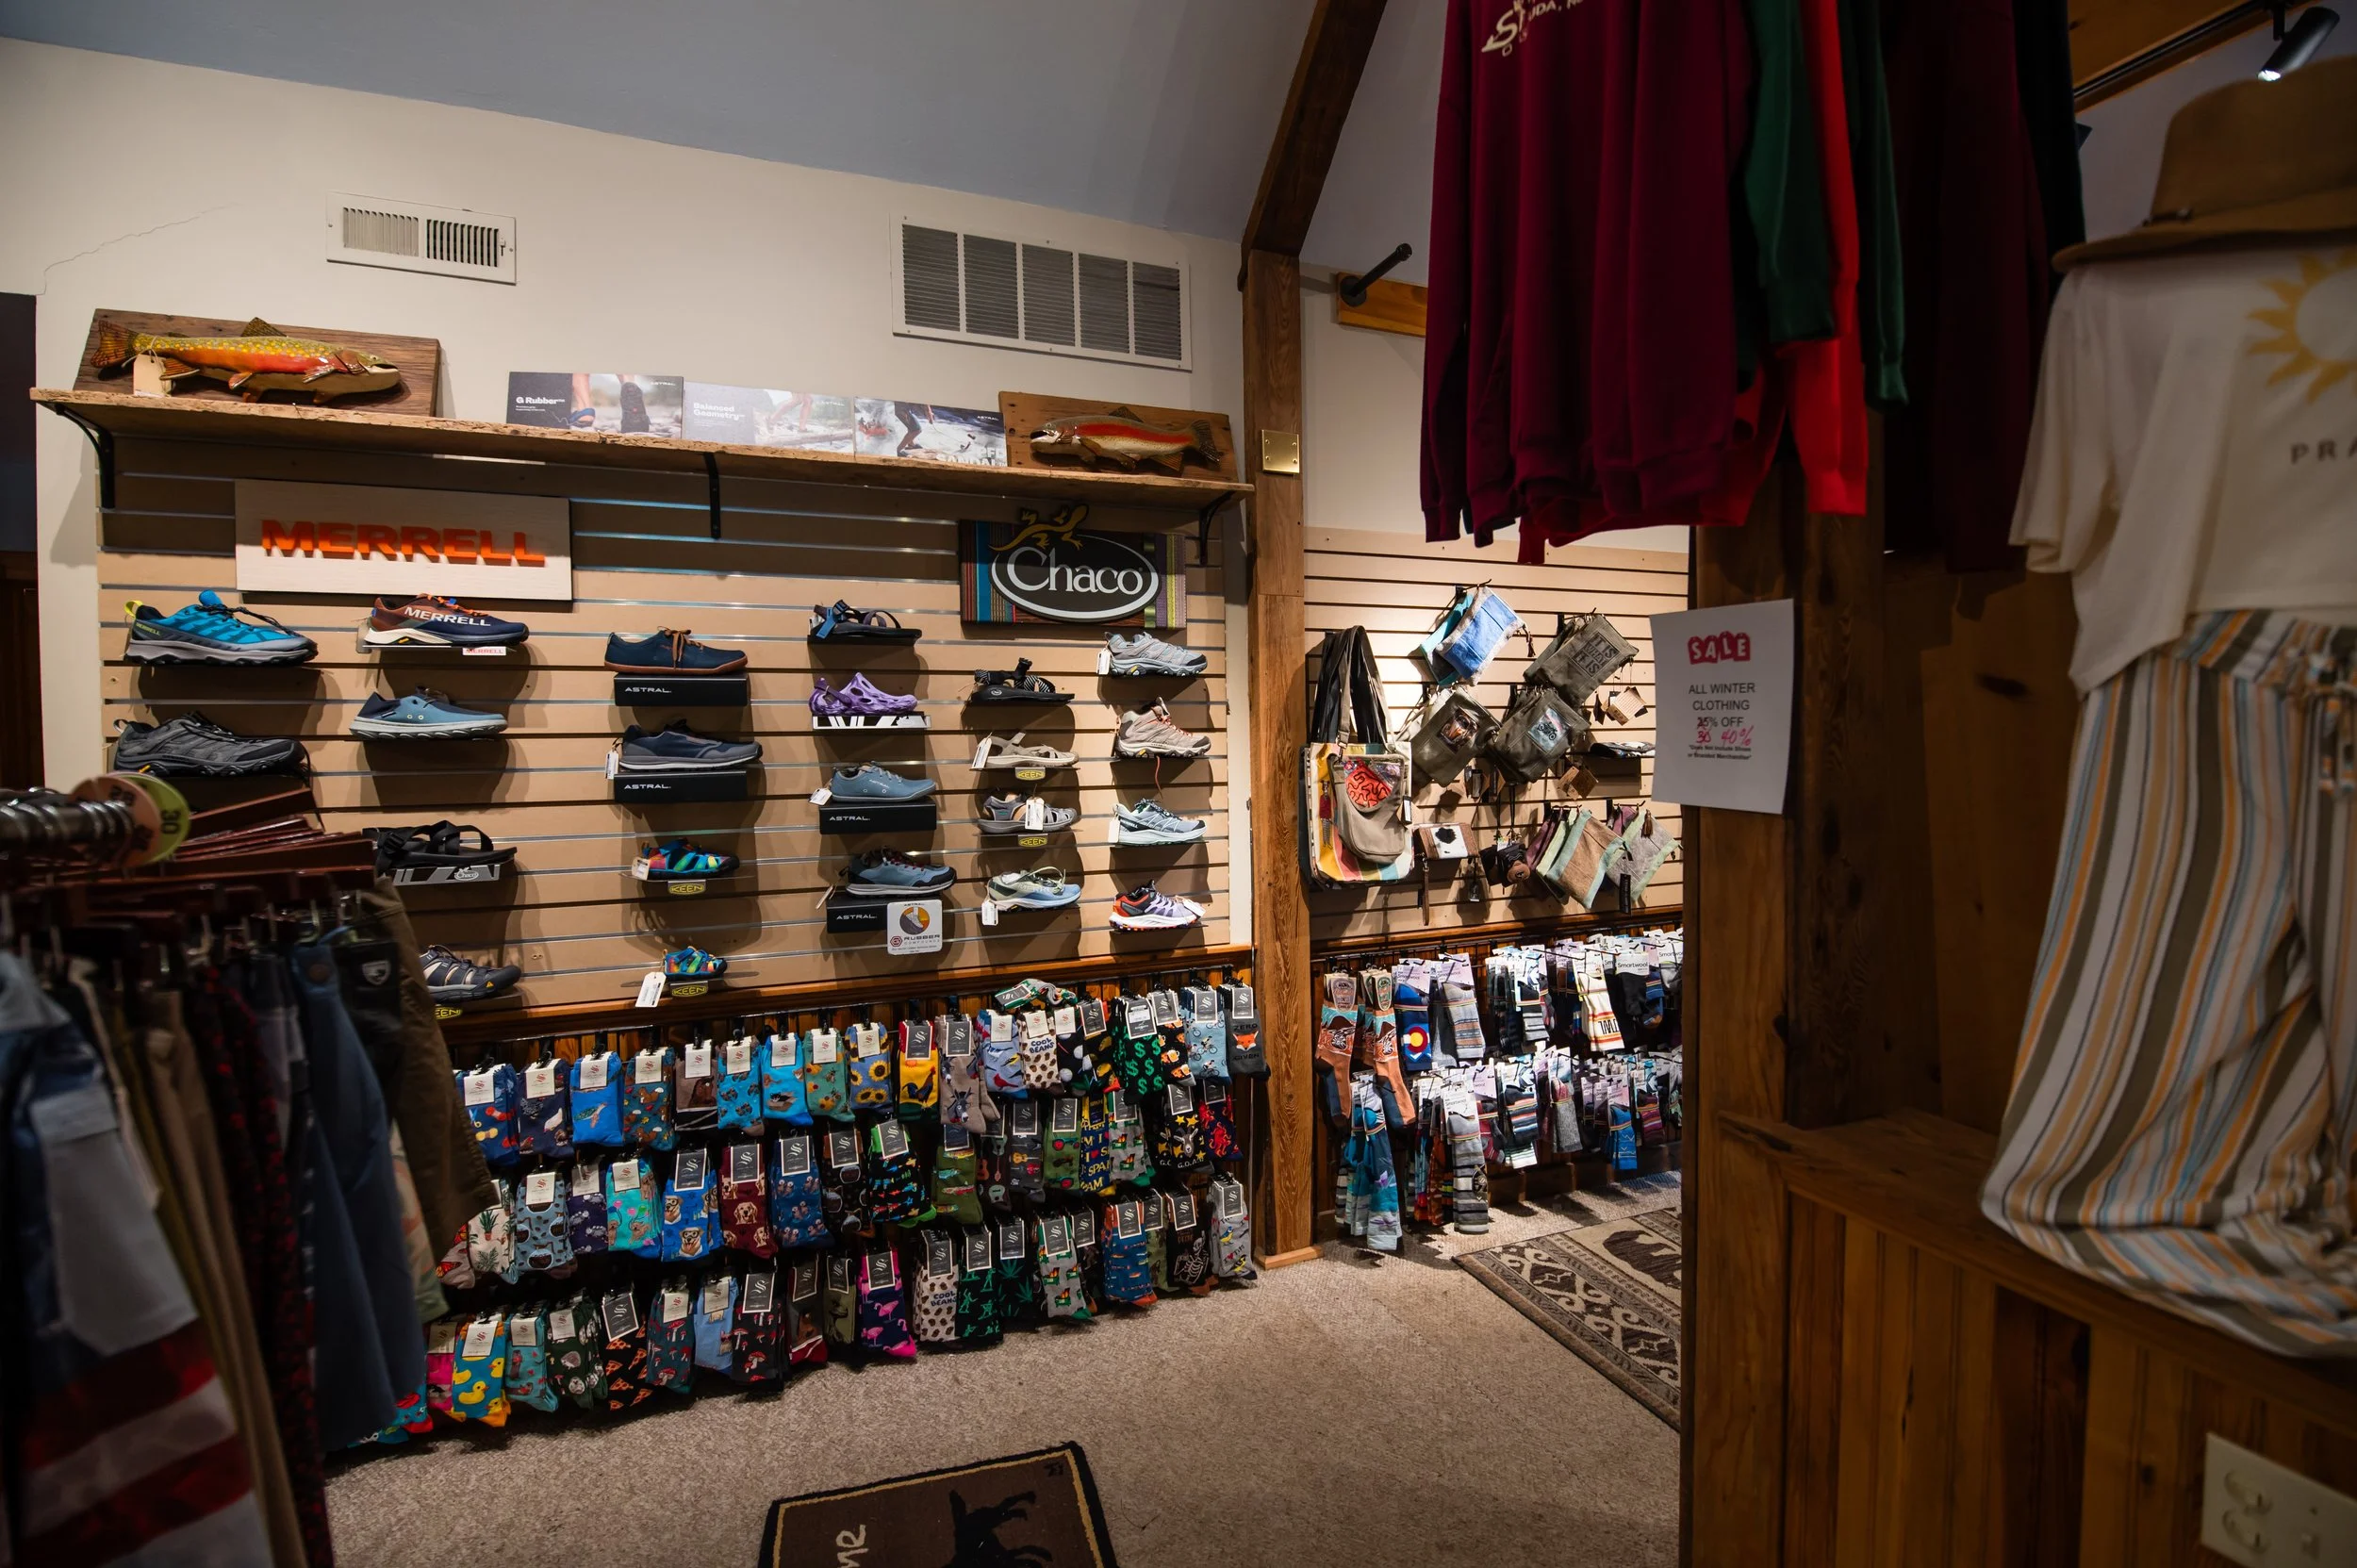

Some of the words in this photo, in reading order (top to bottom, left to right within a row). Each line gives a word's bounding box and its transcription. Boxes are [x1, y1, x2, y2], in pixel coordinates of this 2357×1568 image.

[693, 402, 734, 412] Balanced
[261, 520, 546, 567] MERRELL
[1006, 546, 1144, 595] Chaco
[404, 606, 491, 627] MERRELL
[1689, 633, 1749, 662] SALE
[1689, 684, 1707, 695] ALL
[1709, 683, 1755, 694] WINTER
[1692, 700, 1751, 711] CLOTHING
[1721, 717, 1744, 727] OFF
[1017, 771, 1044, 780] KEEN
[1020, 838, 1047, 847] KEEN
[670, 884, 703, 894] KEEN
[673, 986, 706, 996] KEEN
[435, 1009, 461, 1018] EEN
[1030, 1038, 1052, 1047] COOL
[1030, 1042, 1055, 1054] BEANS
[933, 1291, 955, 1299] COOL
